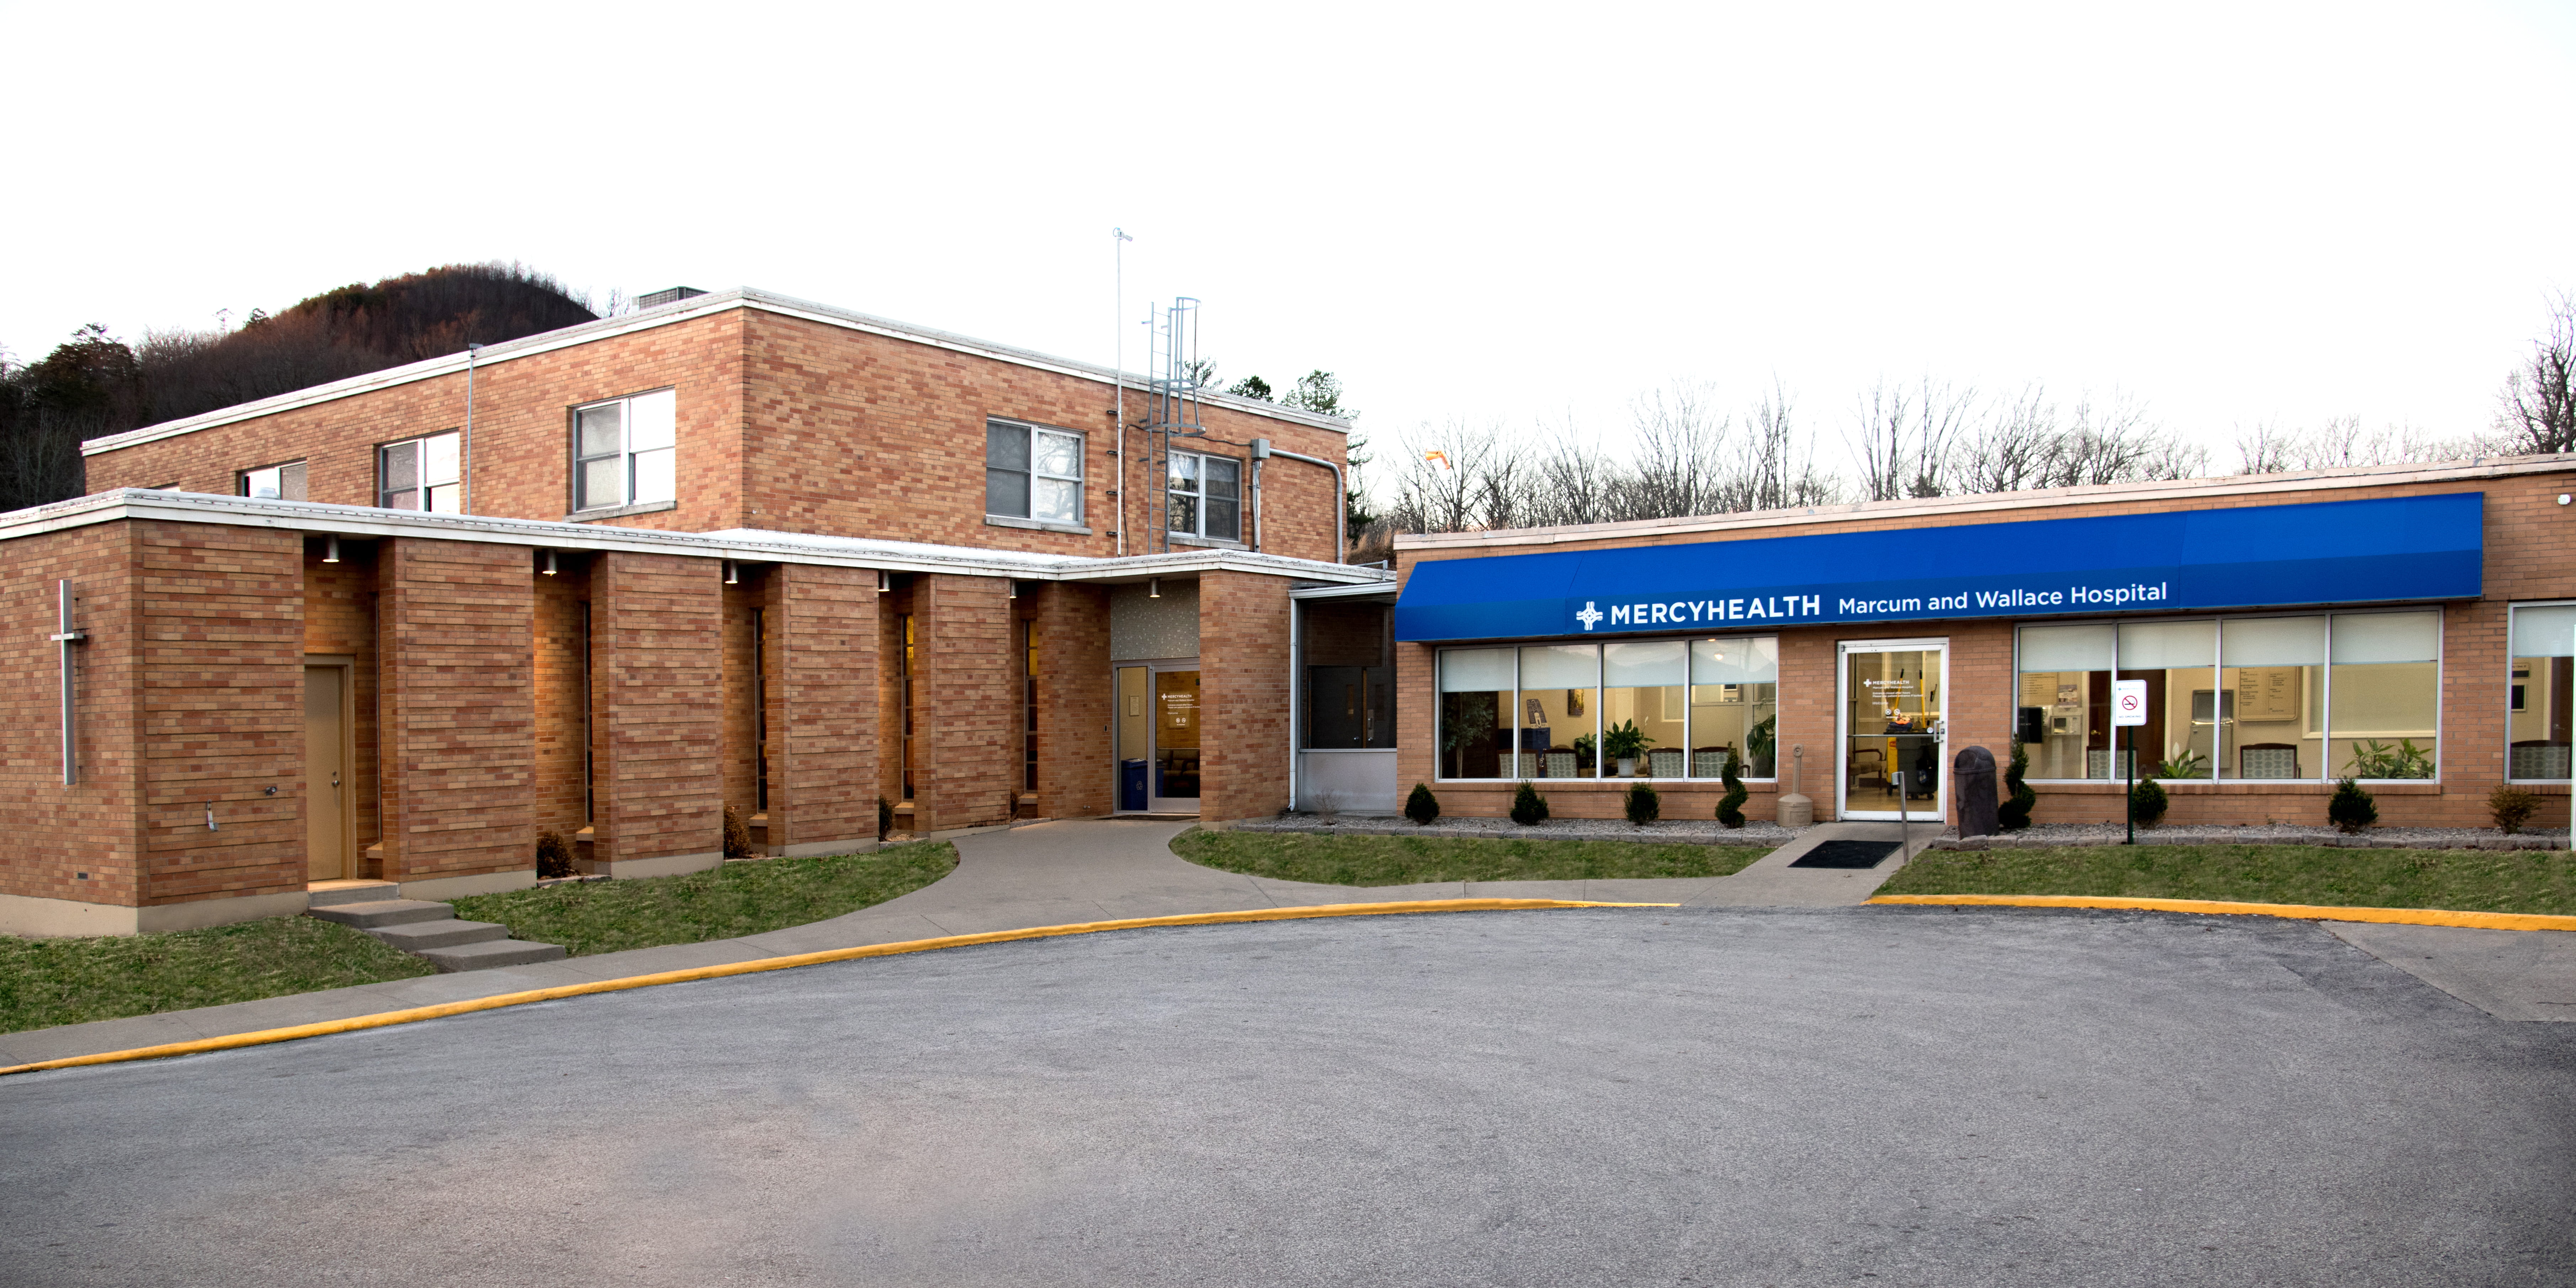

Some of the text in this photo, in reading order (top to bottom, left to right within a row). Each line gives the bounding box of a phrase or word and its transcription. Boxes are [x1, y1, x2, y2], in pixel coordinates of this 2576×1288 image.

[1611, 581, 2166, 625] MERCYHEALTH Marcum and Wallace Hospital
